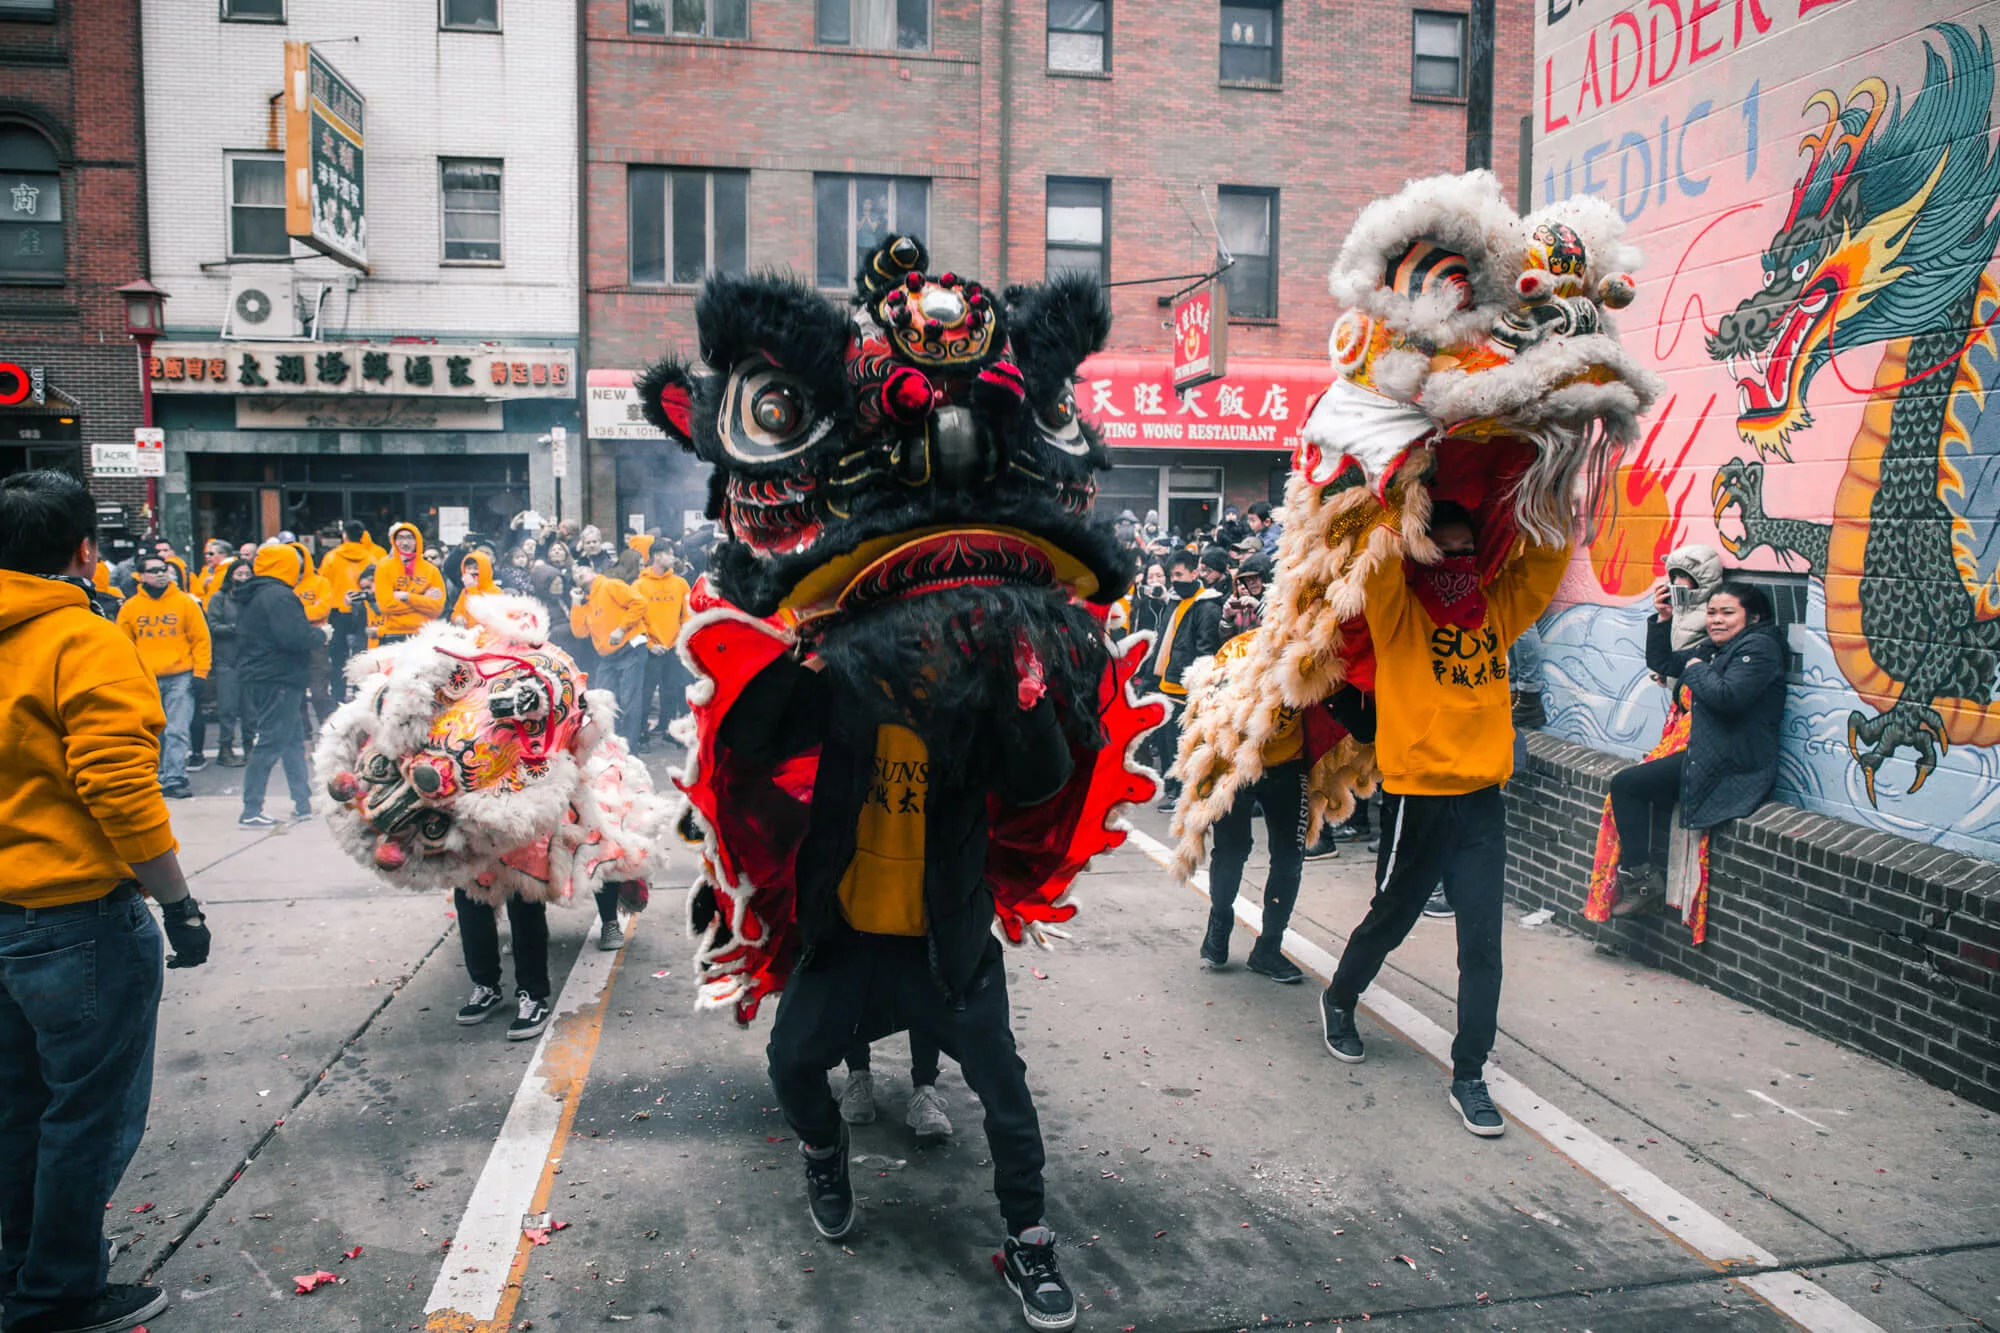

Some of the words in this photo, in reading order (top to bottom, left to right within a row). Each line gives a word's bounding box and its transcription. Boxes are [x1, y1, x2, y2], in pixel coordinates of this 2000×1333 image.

[1743, 78, 1760, 183] 1
[592, 389, 627, 401] NEW
[1103, 422, 1137, 438] TING
[1142, 423, 1183, 440] WONG
[1188, 424, 1277, 442] RESTAURANT
[871, 756, 929, 784] SUNS
[1296, 773, 1309, 844] HOLLISTER
